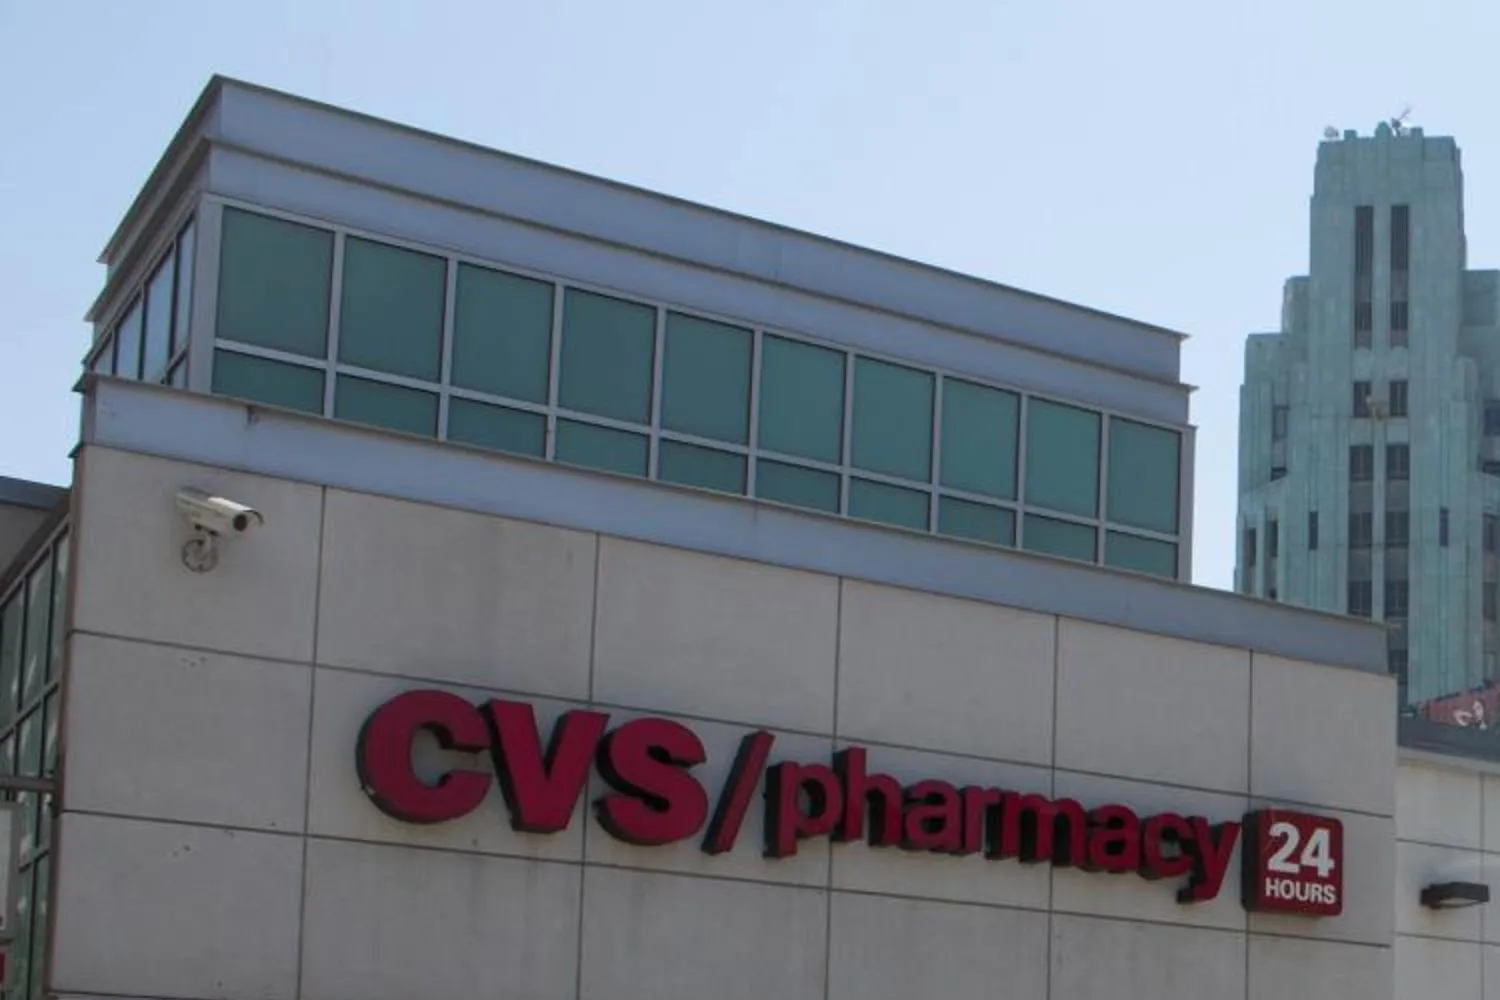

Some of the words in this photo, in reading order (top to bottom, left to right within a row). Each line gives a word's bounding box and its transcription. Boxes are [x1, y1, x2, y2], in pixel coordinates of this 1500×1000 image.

[356, 688, 1242, 905] CVS/pharmacy
[1267, 821, 1336, 878] 24
[1264, 877, 1337, 905] HOURS
